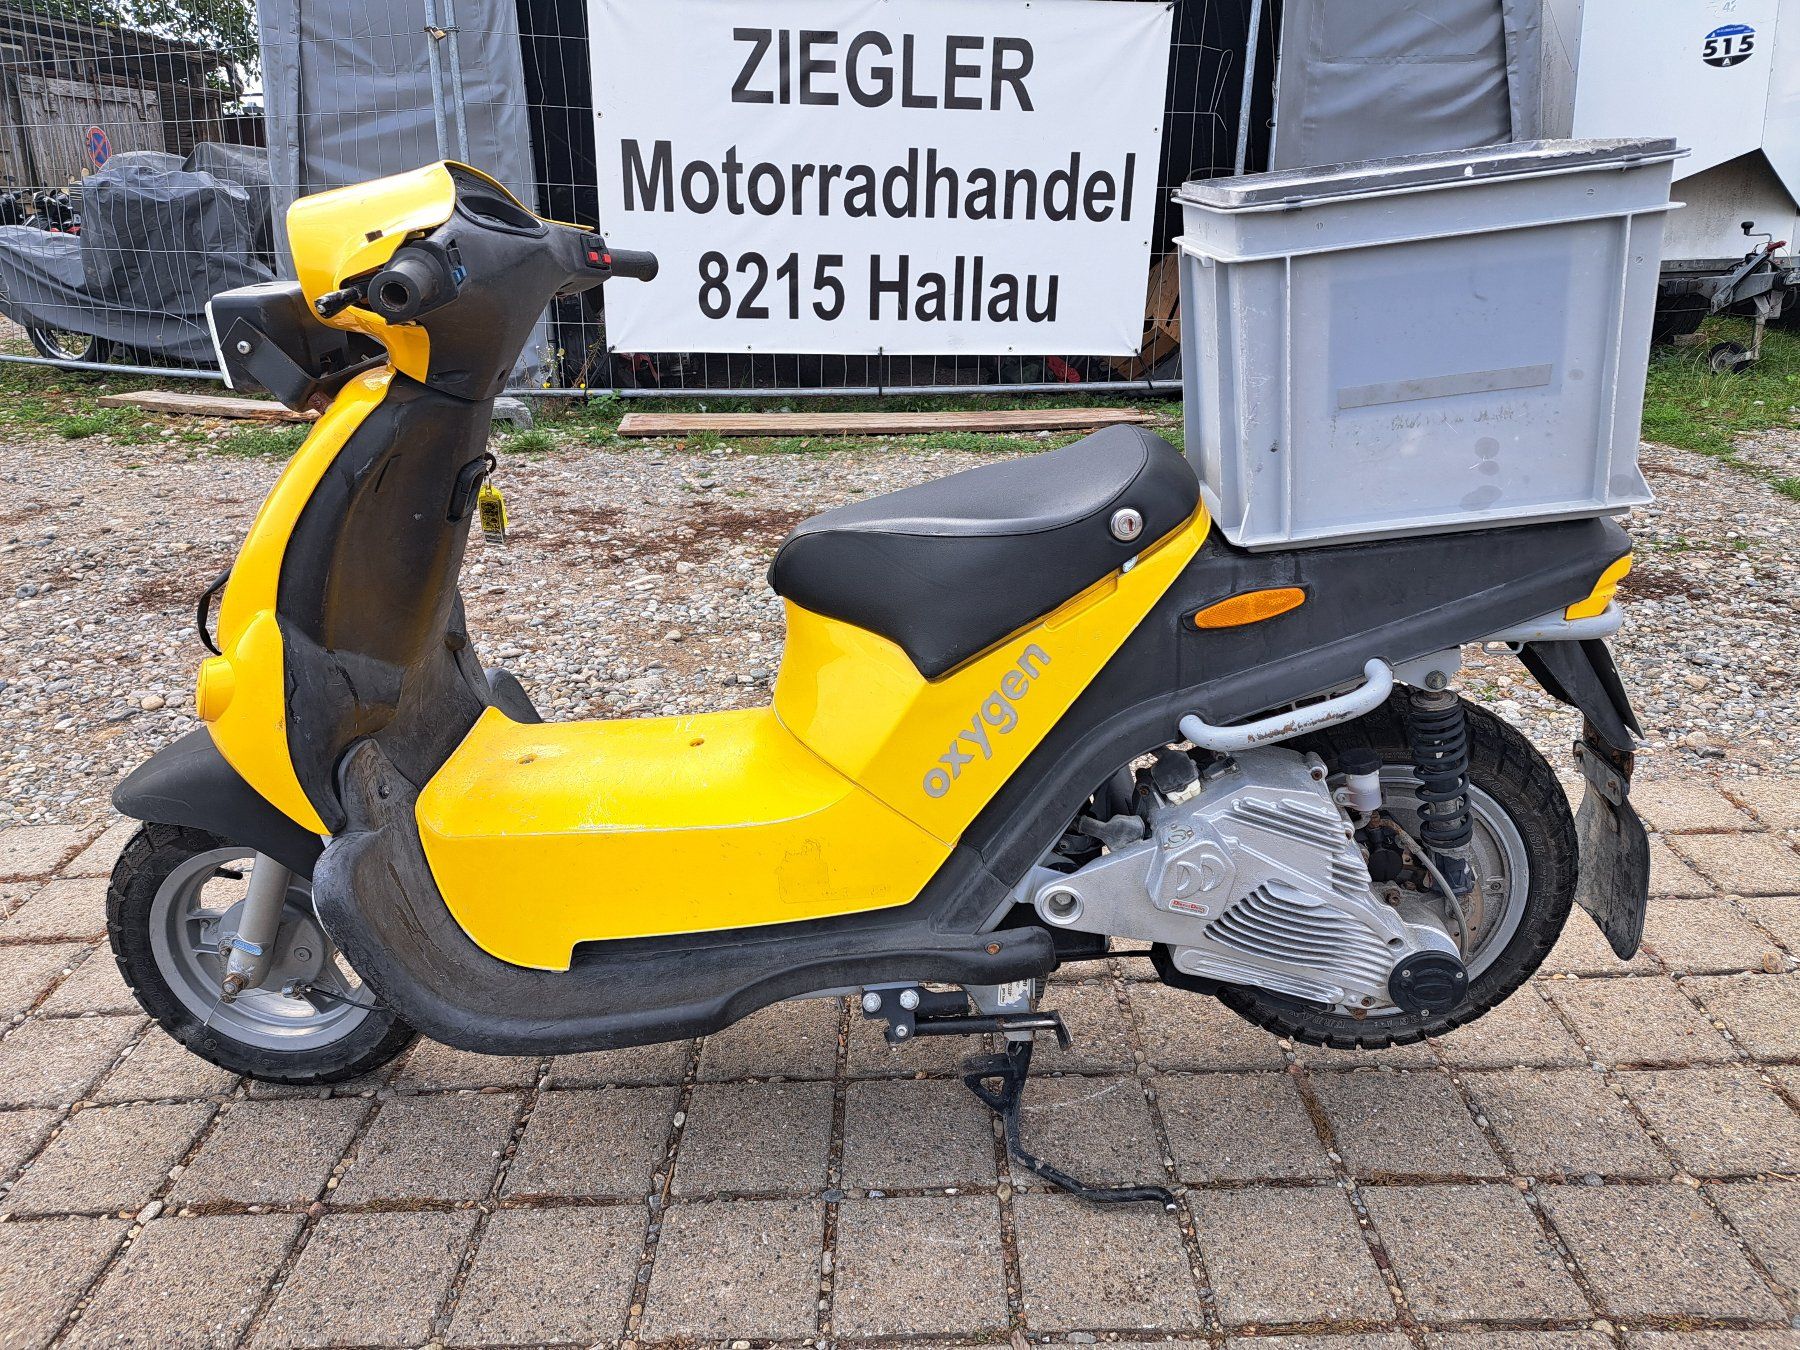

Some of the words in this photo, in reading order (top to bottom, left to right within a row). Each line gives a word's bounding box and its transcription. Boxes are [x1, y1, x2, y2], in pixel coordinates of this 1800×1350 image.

[732, 28, 1034, 111] ZIEGLER
[1702, 34, 1755, 57] 515
[621, 139, 1136, 223] Motorradhandel
[698, 250, 845, 321] 8215
[870, 253, 1059, 323] Hallau
[923, 642, 1052, 799] oxygen
